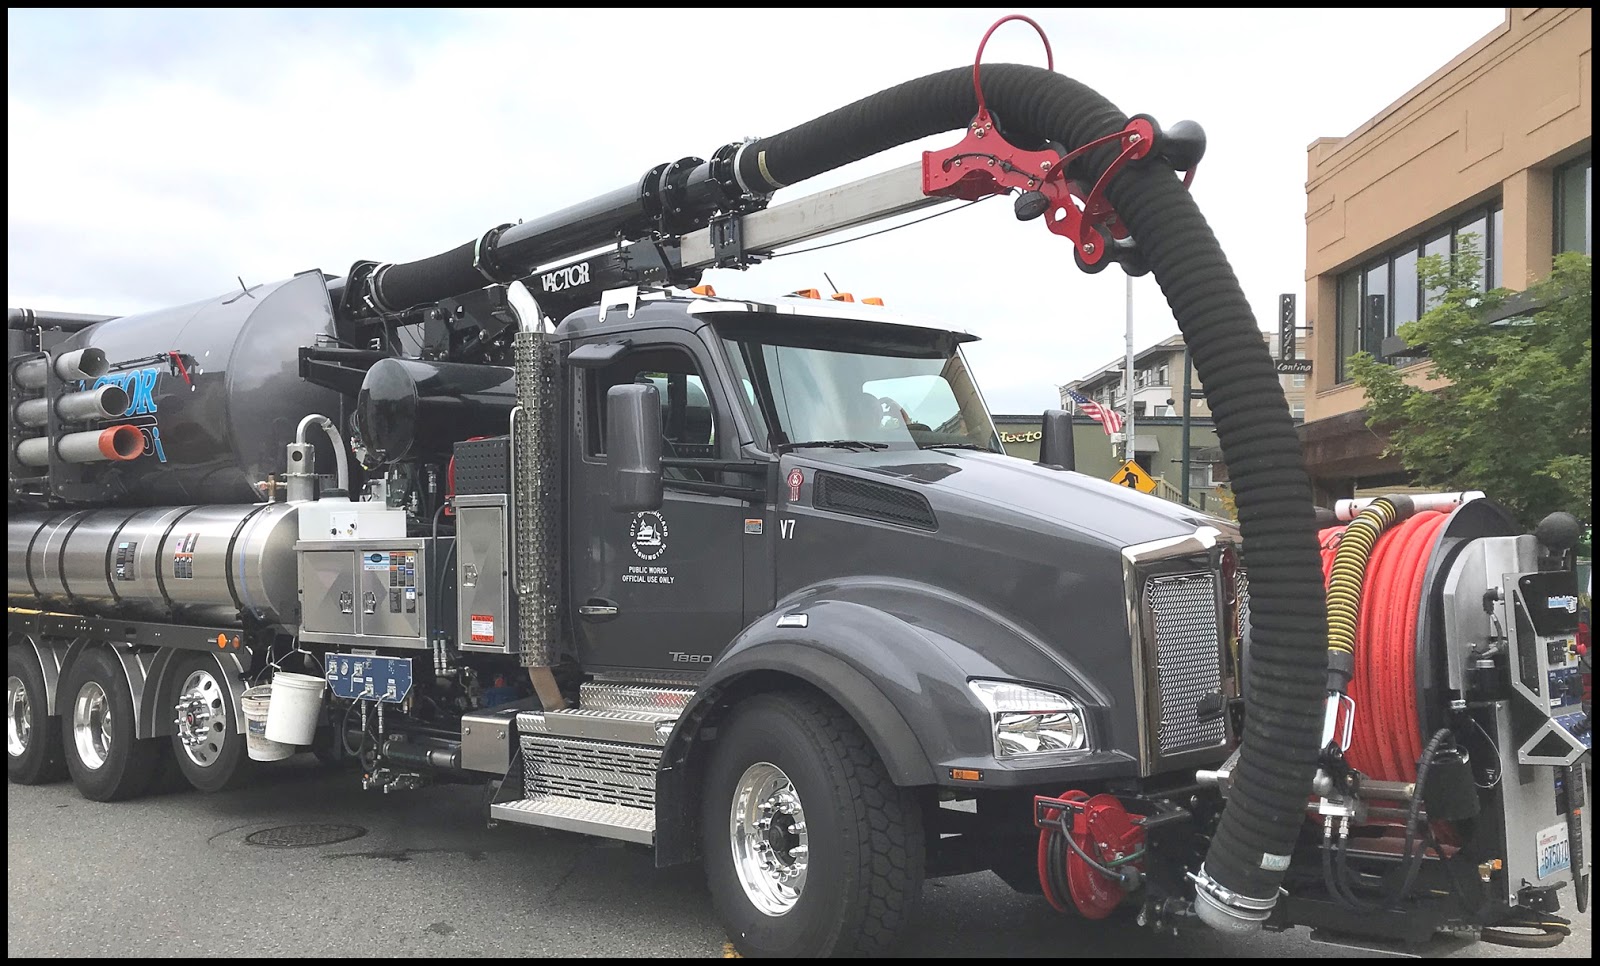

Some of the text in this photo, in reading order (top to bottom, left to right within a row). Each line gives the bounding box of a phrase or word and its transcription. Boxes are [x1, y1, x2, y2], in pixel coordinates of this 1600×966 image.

[541, 262, 590, 292] VACTOR
[1277, 362, 1312, 372] Cantina
[780, 519, 796, 539] V7
[631, 542, 667, 561] WASHINGTON
[628, 566, 668, 575] PUBLIC WORKS
[622, 575, 675, 584] OFFICIAL USE ONLY
[668, 651, 713, 663] T880
